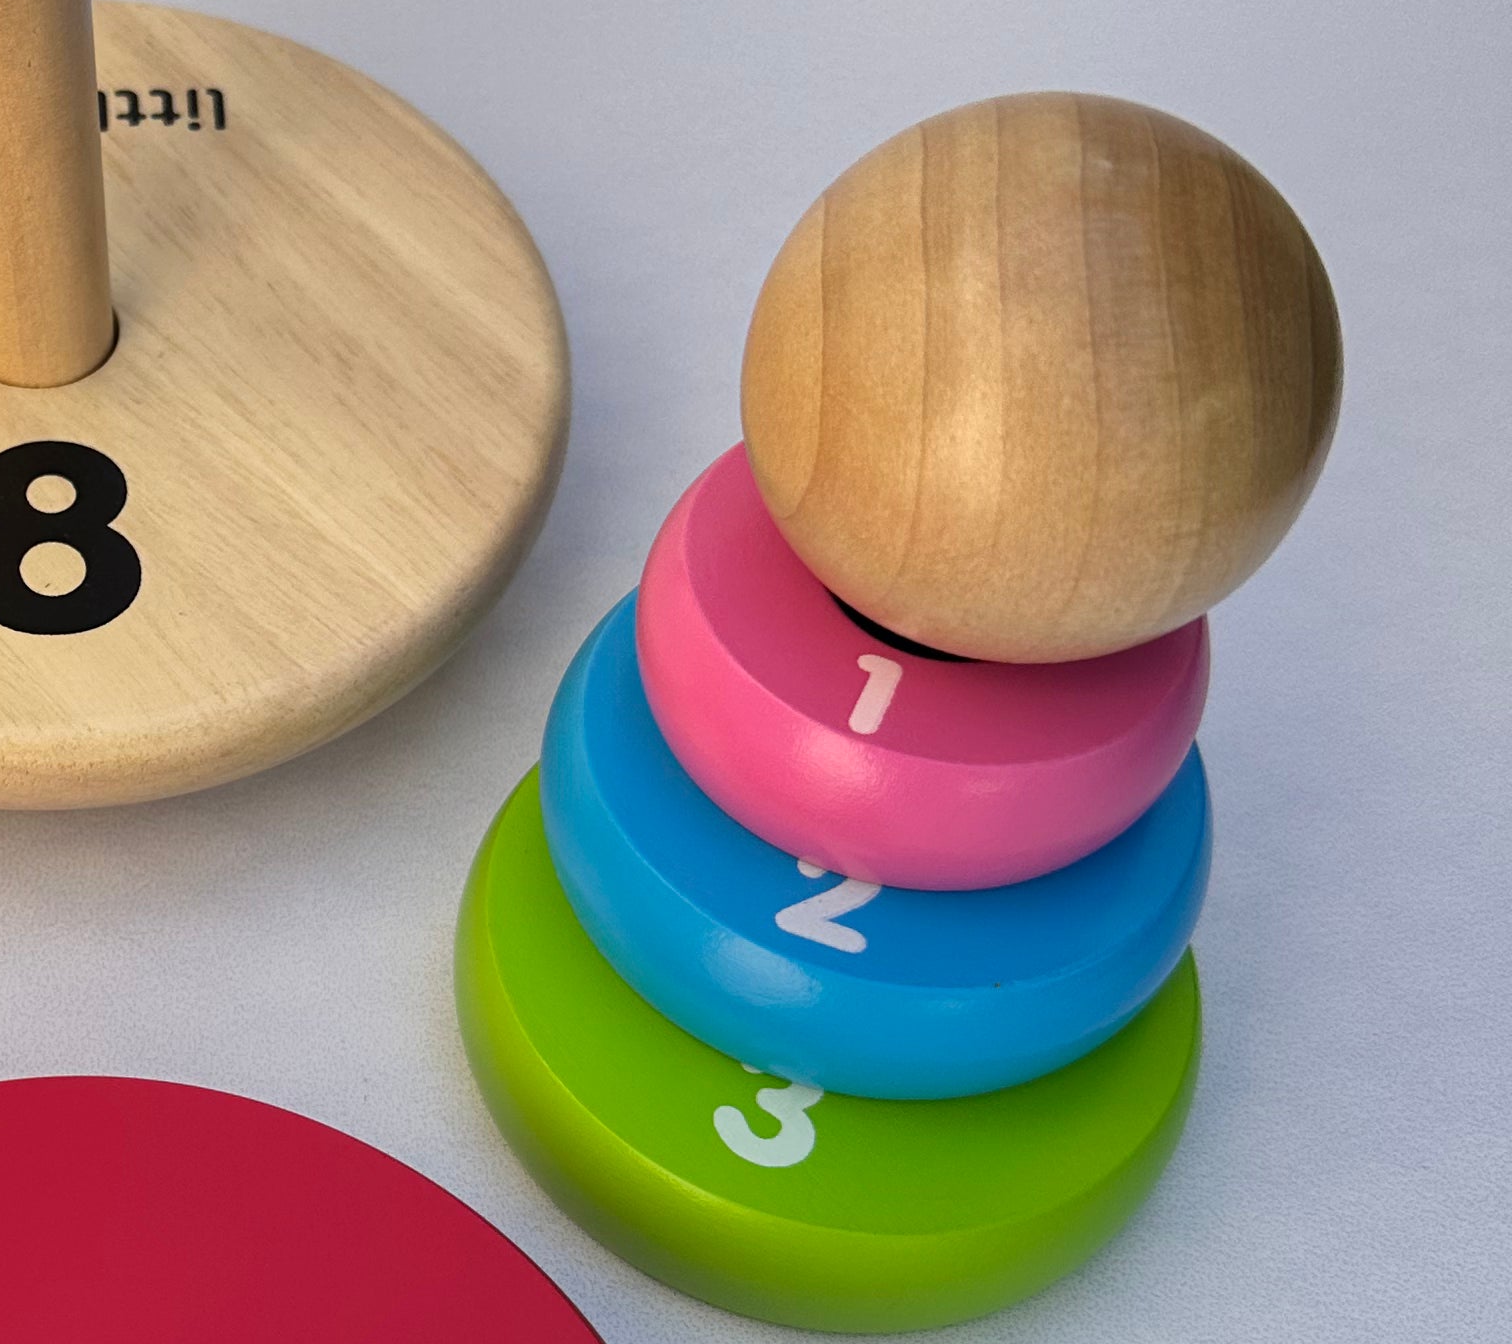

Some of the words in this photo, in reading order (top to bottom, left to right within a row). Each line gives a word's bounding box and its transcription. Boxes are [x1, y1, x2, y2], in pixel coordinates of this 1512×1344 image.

[96, 87, 227, 133] littl
[847, 654, 903, 735] 1
[774, 859, 883, 954] 2
[713, 1062, 825, 1168] 3
